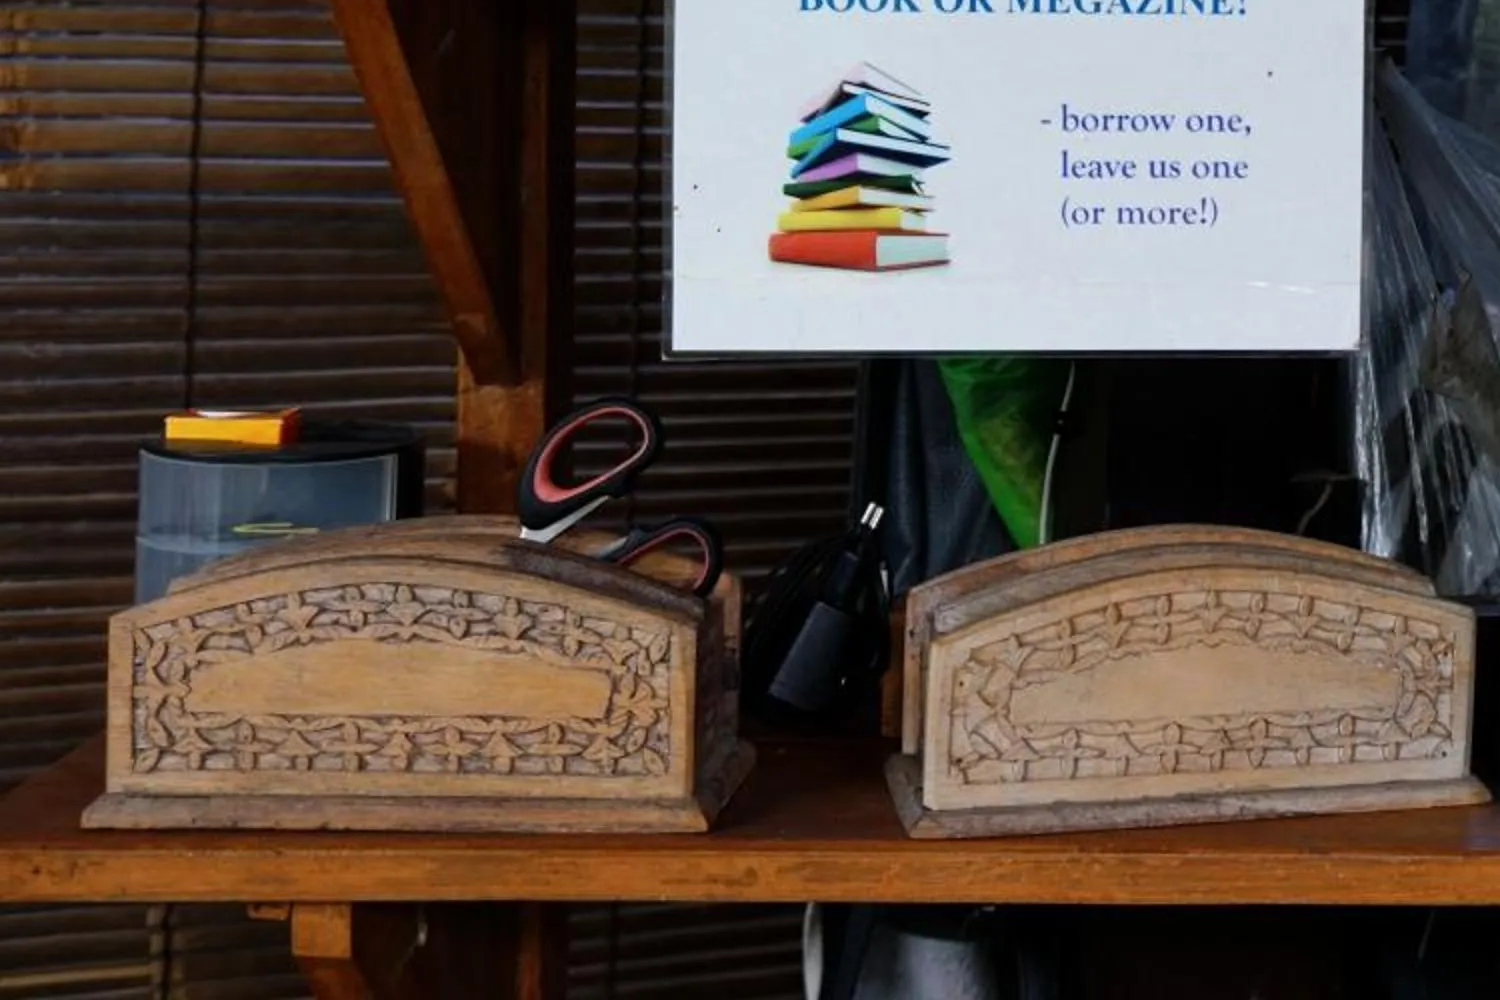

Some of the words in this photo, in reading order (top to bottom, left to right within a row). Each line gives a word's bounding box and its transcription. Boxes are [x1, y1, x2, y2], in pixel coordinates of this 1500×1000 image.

[1061, 104, 1175, 133] borrow
[1185, 111, 1252, 136] one,
[1061, 150, 1137, 180] leave
[1148, 158, 1182, 180] us
[1191, 159, 1249, 180] one
[1061, 198, 1105, 227] (or
[1116, 198, 1219, 227] more!)
